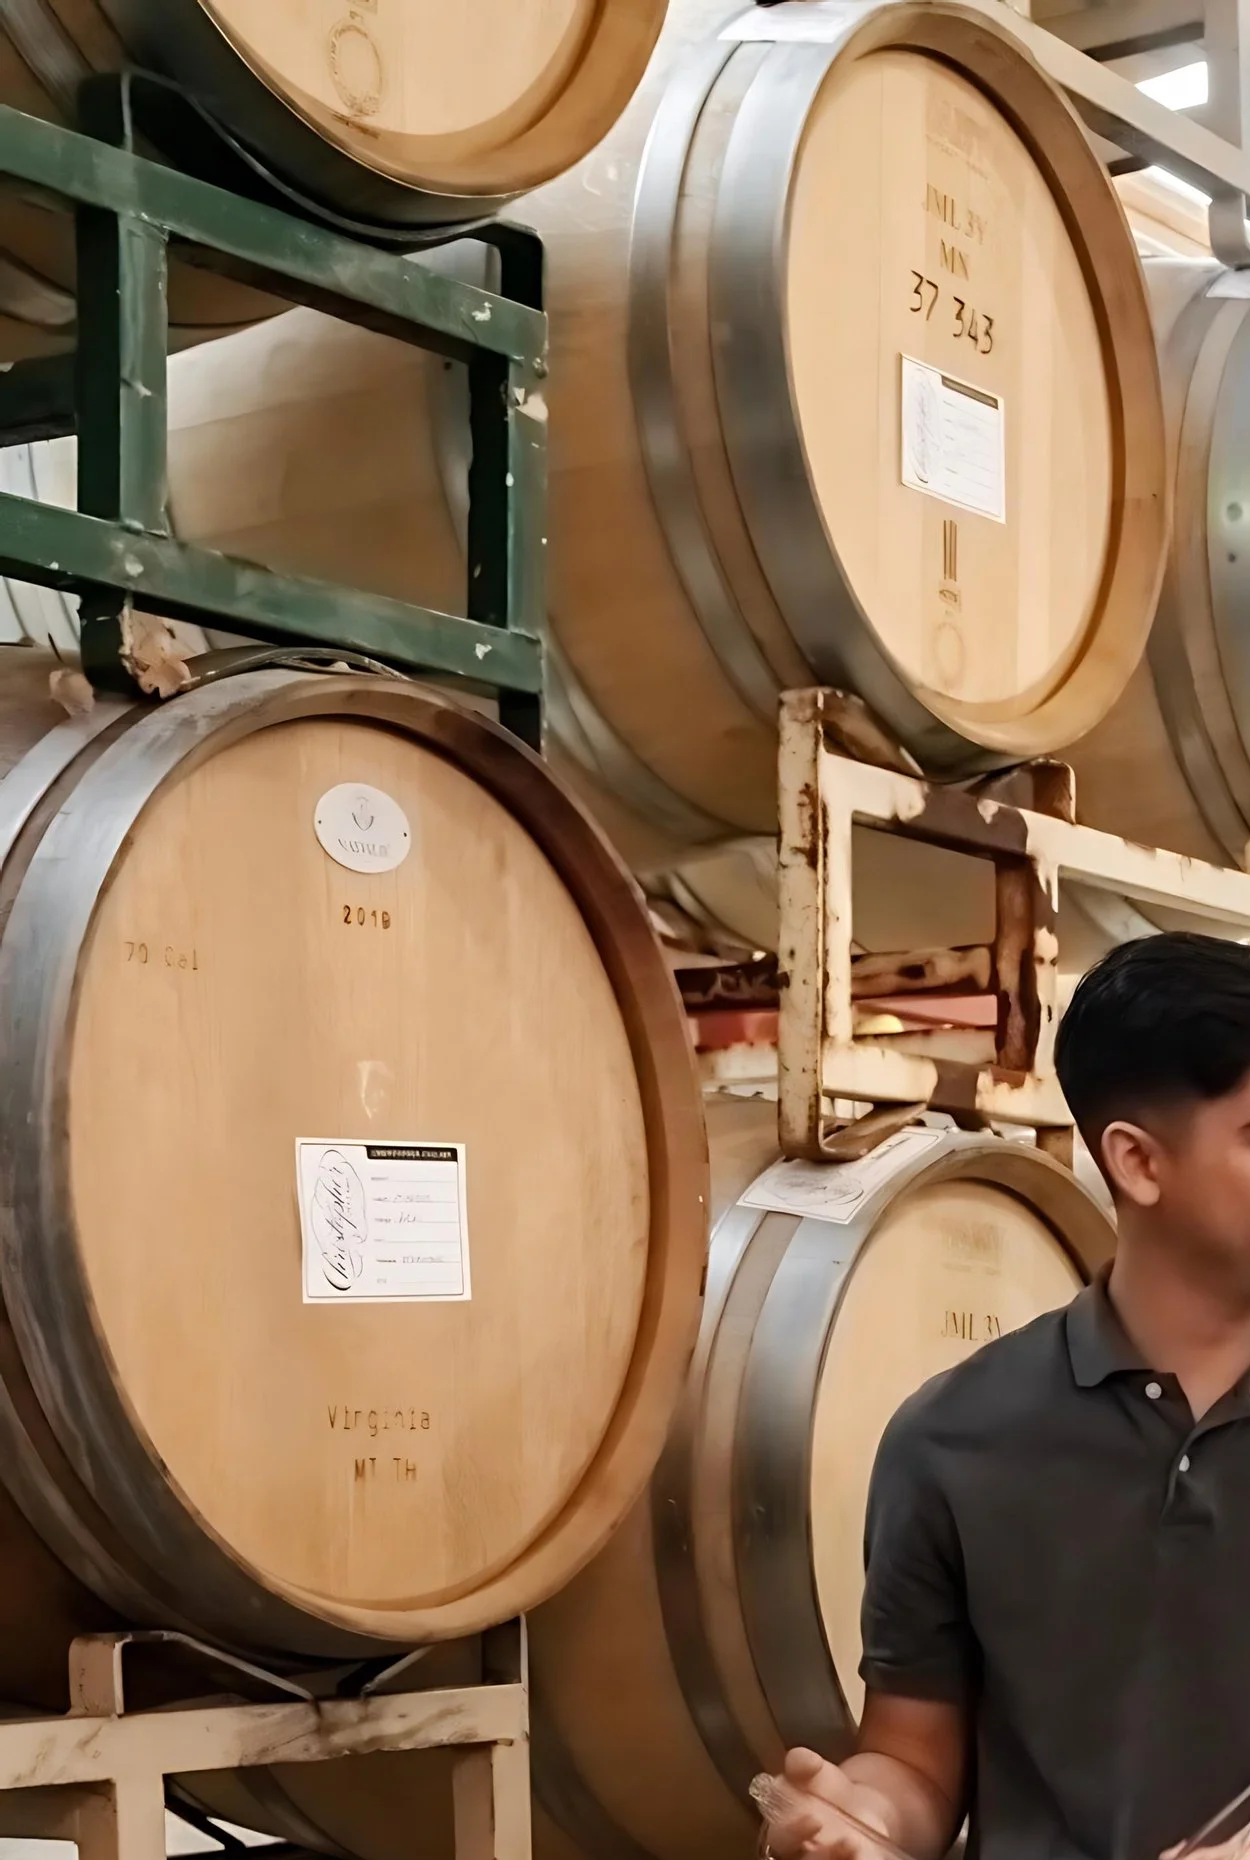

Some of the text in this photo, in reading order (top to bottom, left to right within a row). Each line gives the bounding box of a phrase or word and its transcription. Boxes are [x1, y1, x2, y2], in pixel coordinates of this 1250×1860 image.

[909, 269, 995, 355] 37 343
[327, 1404, 431, 1438] Virginia
[392, 1457, 418, 1483] TH
